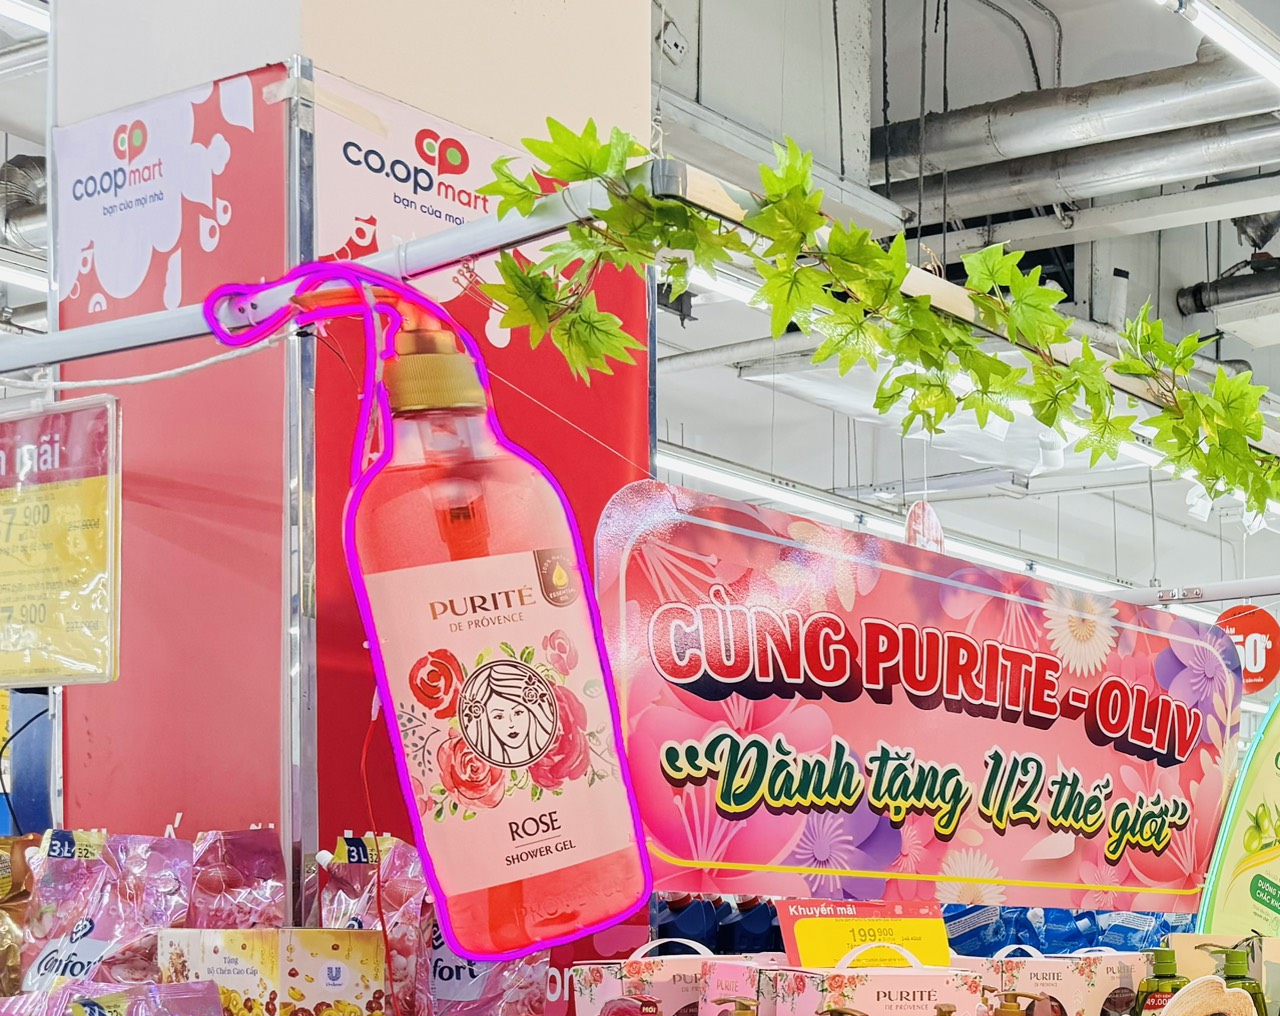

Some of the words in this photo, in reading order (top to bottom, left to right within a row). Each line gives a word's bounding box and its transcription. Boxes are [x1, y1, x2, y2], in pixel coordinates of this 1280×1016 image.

[393, 192, 417, 209] bạn
[420, 204, 442, 219] của
[429, 584, 537, 621] PURITÉ
[448, 620, 465, 633] DE
[648, 584, 856, 690] CÙNG
[868, 747, 968, 836] tặng
[981, 748, 1042, 831] 1/2
[1050, 763, 1107, 834] thế
[508, 811, 562, 842] ROSE
[505, 845, 553, 867] SHOWER
[555, 839, 577, 854] GEL
[789, 903, 835, 917] Khuyến
[837, 905, 857, 915] mãi
[216, 967, 232, 976] Chén
[233, 967, 245, 976] Cao
[246, 965, 258, 977] Cấp
